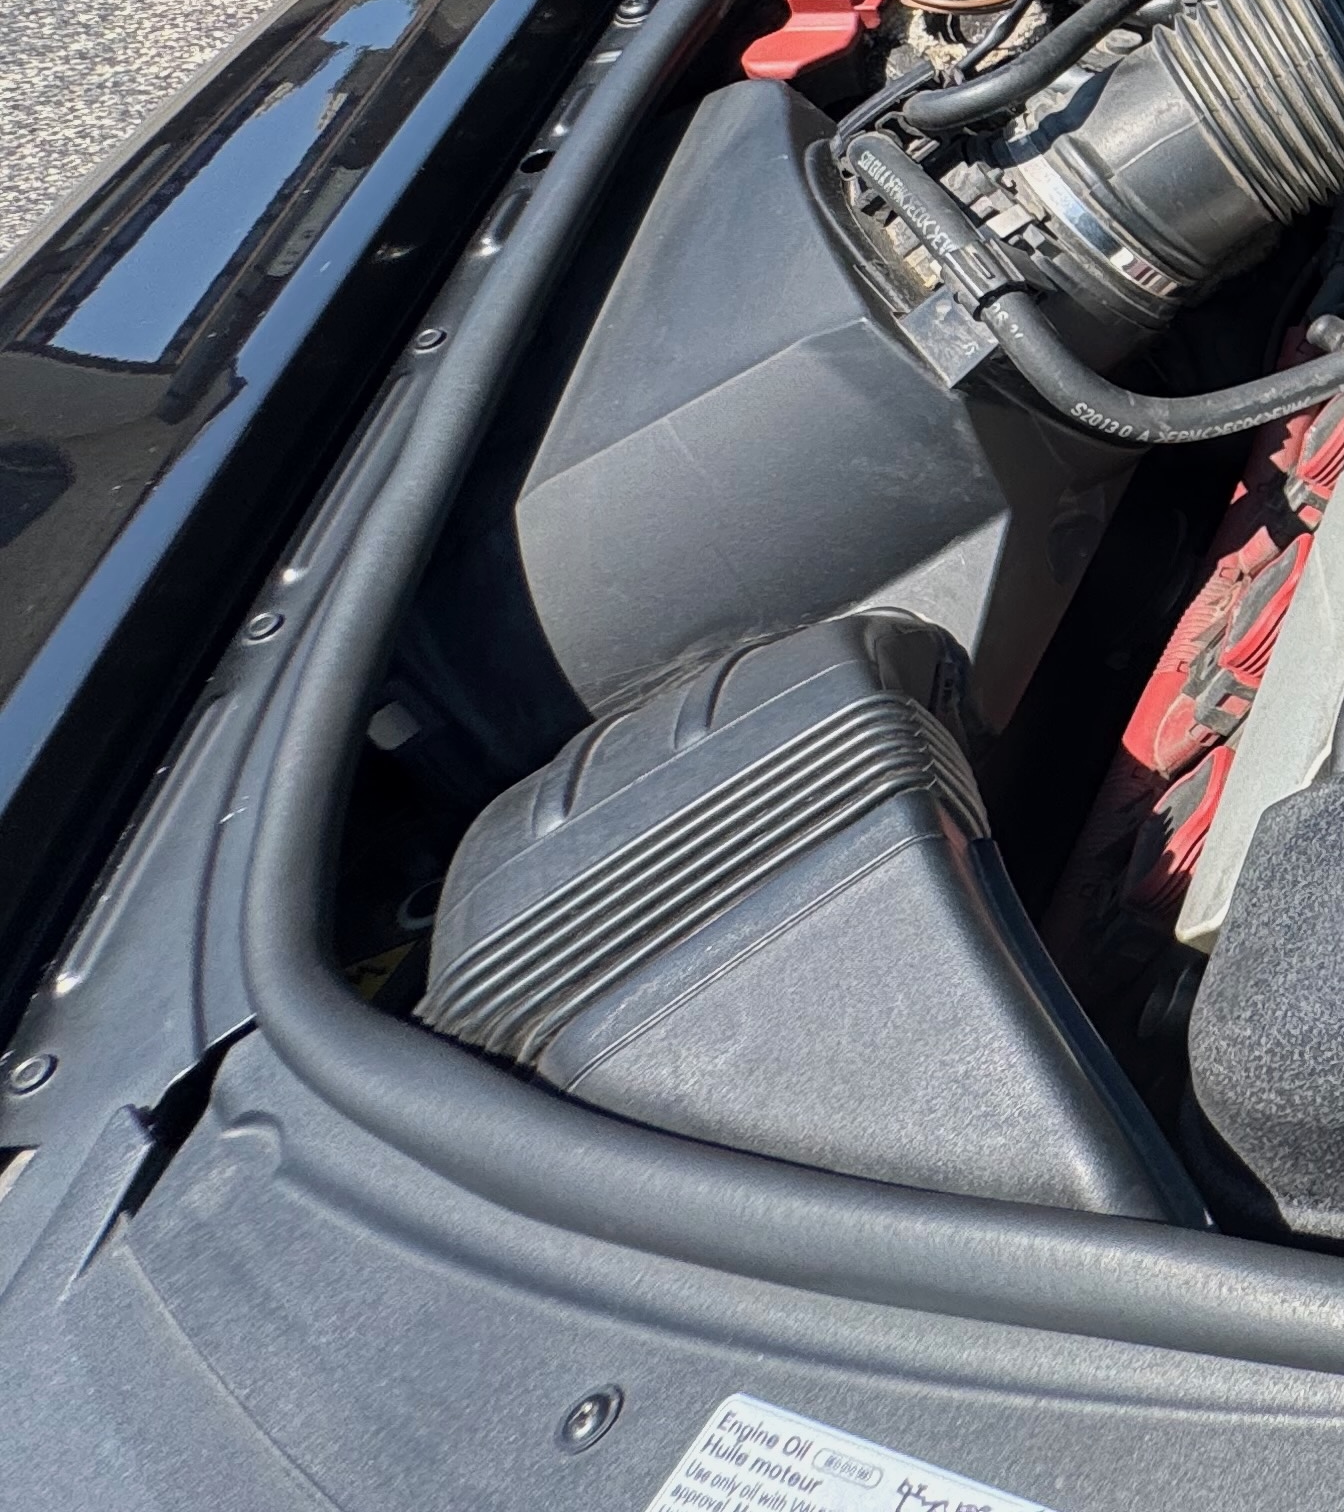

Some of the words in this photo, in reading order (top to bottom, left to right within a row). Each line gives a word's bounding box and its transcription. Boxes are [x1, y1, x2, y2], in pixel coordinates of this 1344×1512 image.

[716, 1410, 781, 1450] Engine
[782, 1435, 814, 1461] Oil
[685, 1459, 712, 1483] Use
[710, 1473, 741, 1497] only
[739, 1482, 764, 1502] oil
[757, 1490, 788, 1512] with
[700, 1433, 749, 1467] Huile
[748, 1456, 824, 1494] moteur
